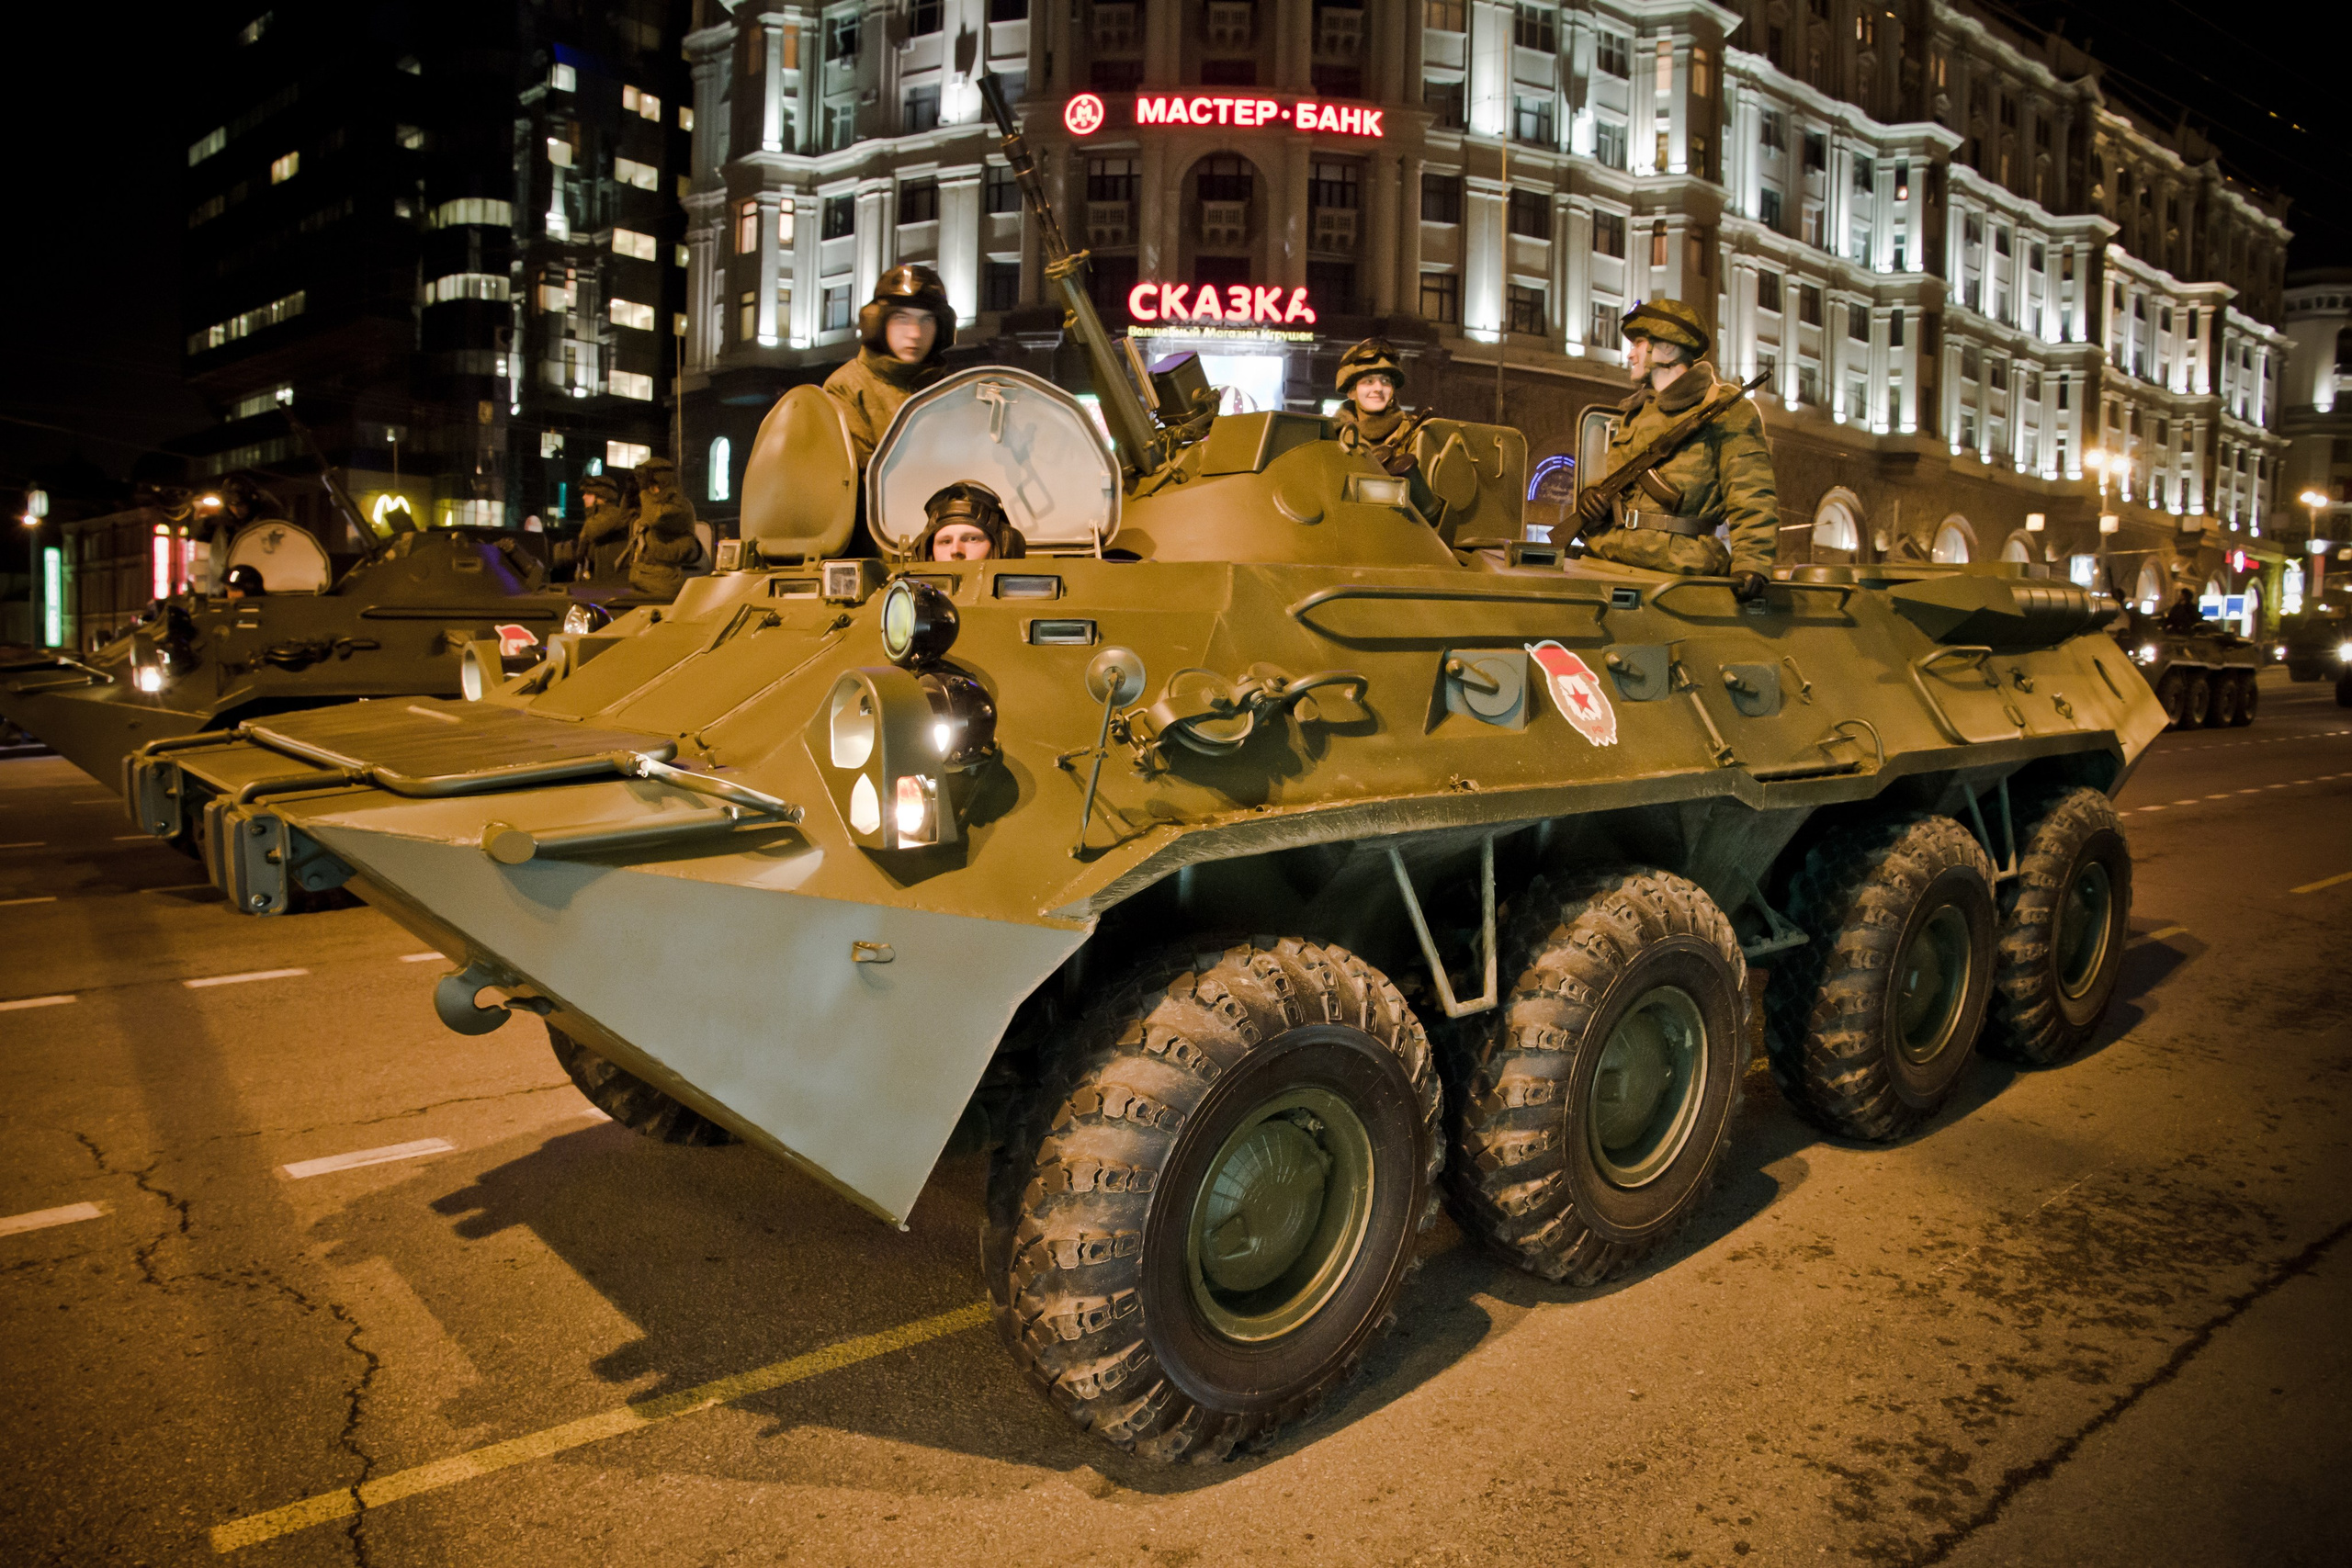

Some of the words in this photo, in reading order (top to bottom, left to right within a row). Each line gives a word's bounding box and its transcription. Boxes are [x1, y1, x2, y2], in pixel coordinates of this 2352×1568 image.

[1128, 282, 1317, 324] СКАЗКА
[1127, 324, 1201, 338] Волшебный
[1202, 326, 1258, 339] Магазин
[1260, 329, 1315, 343] Игрушек
